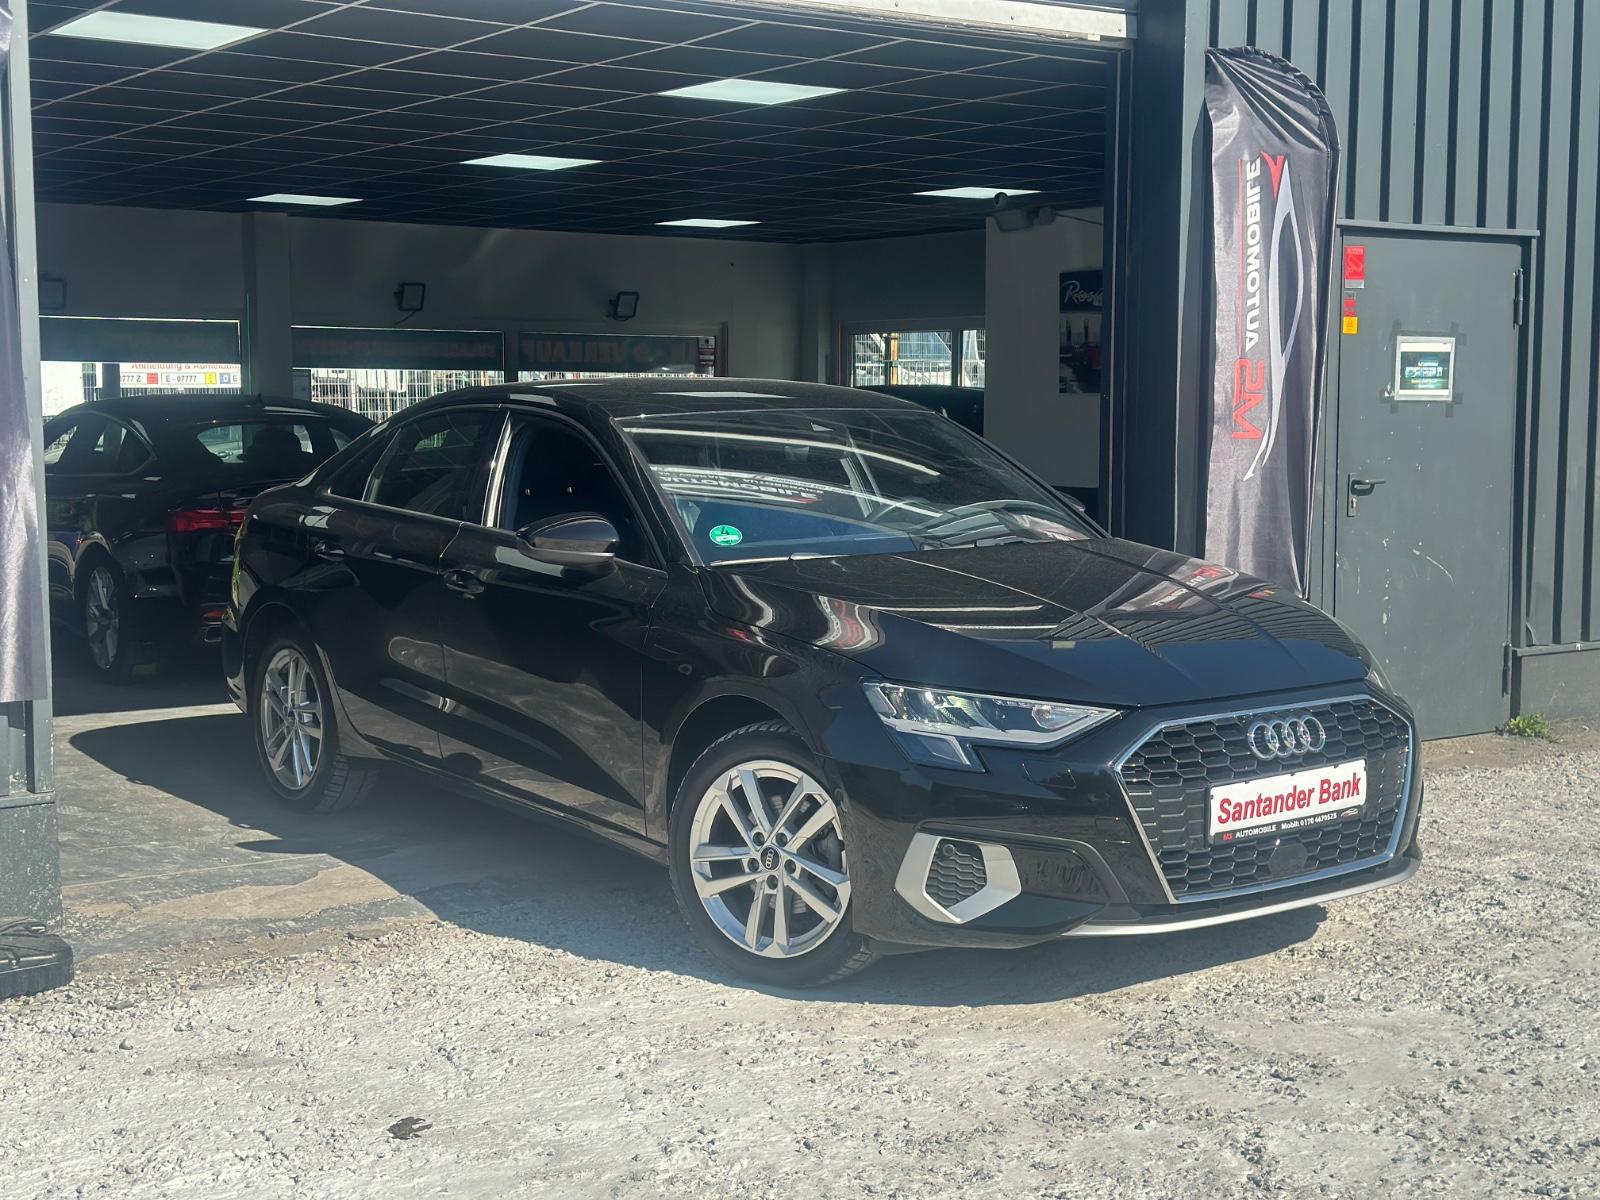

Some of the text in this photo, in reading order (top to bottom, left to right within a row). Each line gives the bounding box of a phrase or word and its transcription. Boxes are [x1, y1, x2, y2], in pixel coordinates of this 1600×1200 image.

[721, 526, 730, 536] 4
[1217, 772, 1361, 825] Santander Bank
[1235, 824, 1276, 839] AUTOMOBILE
